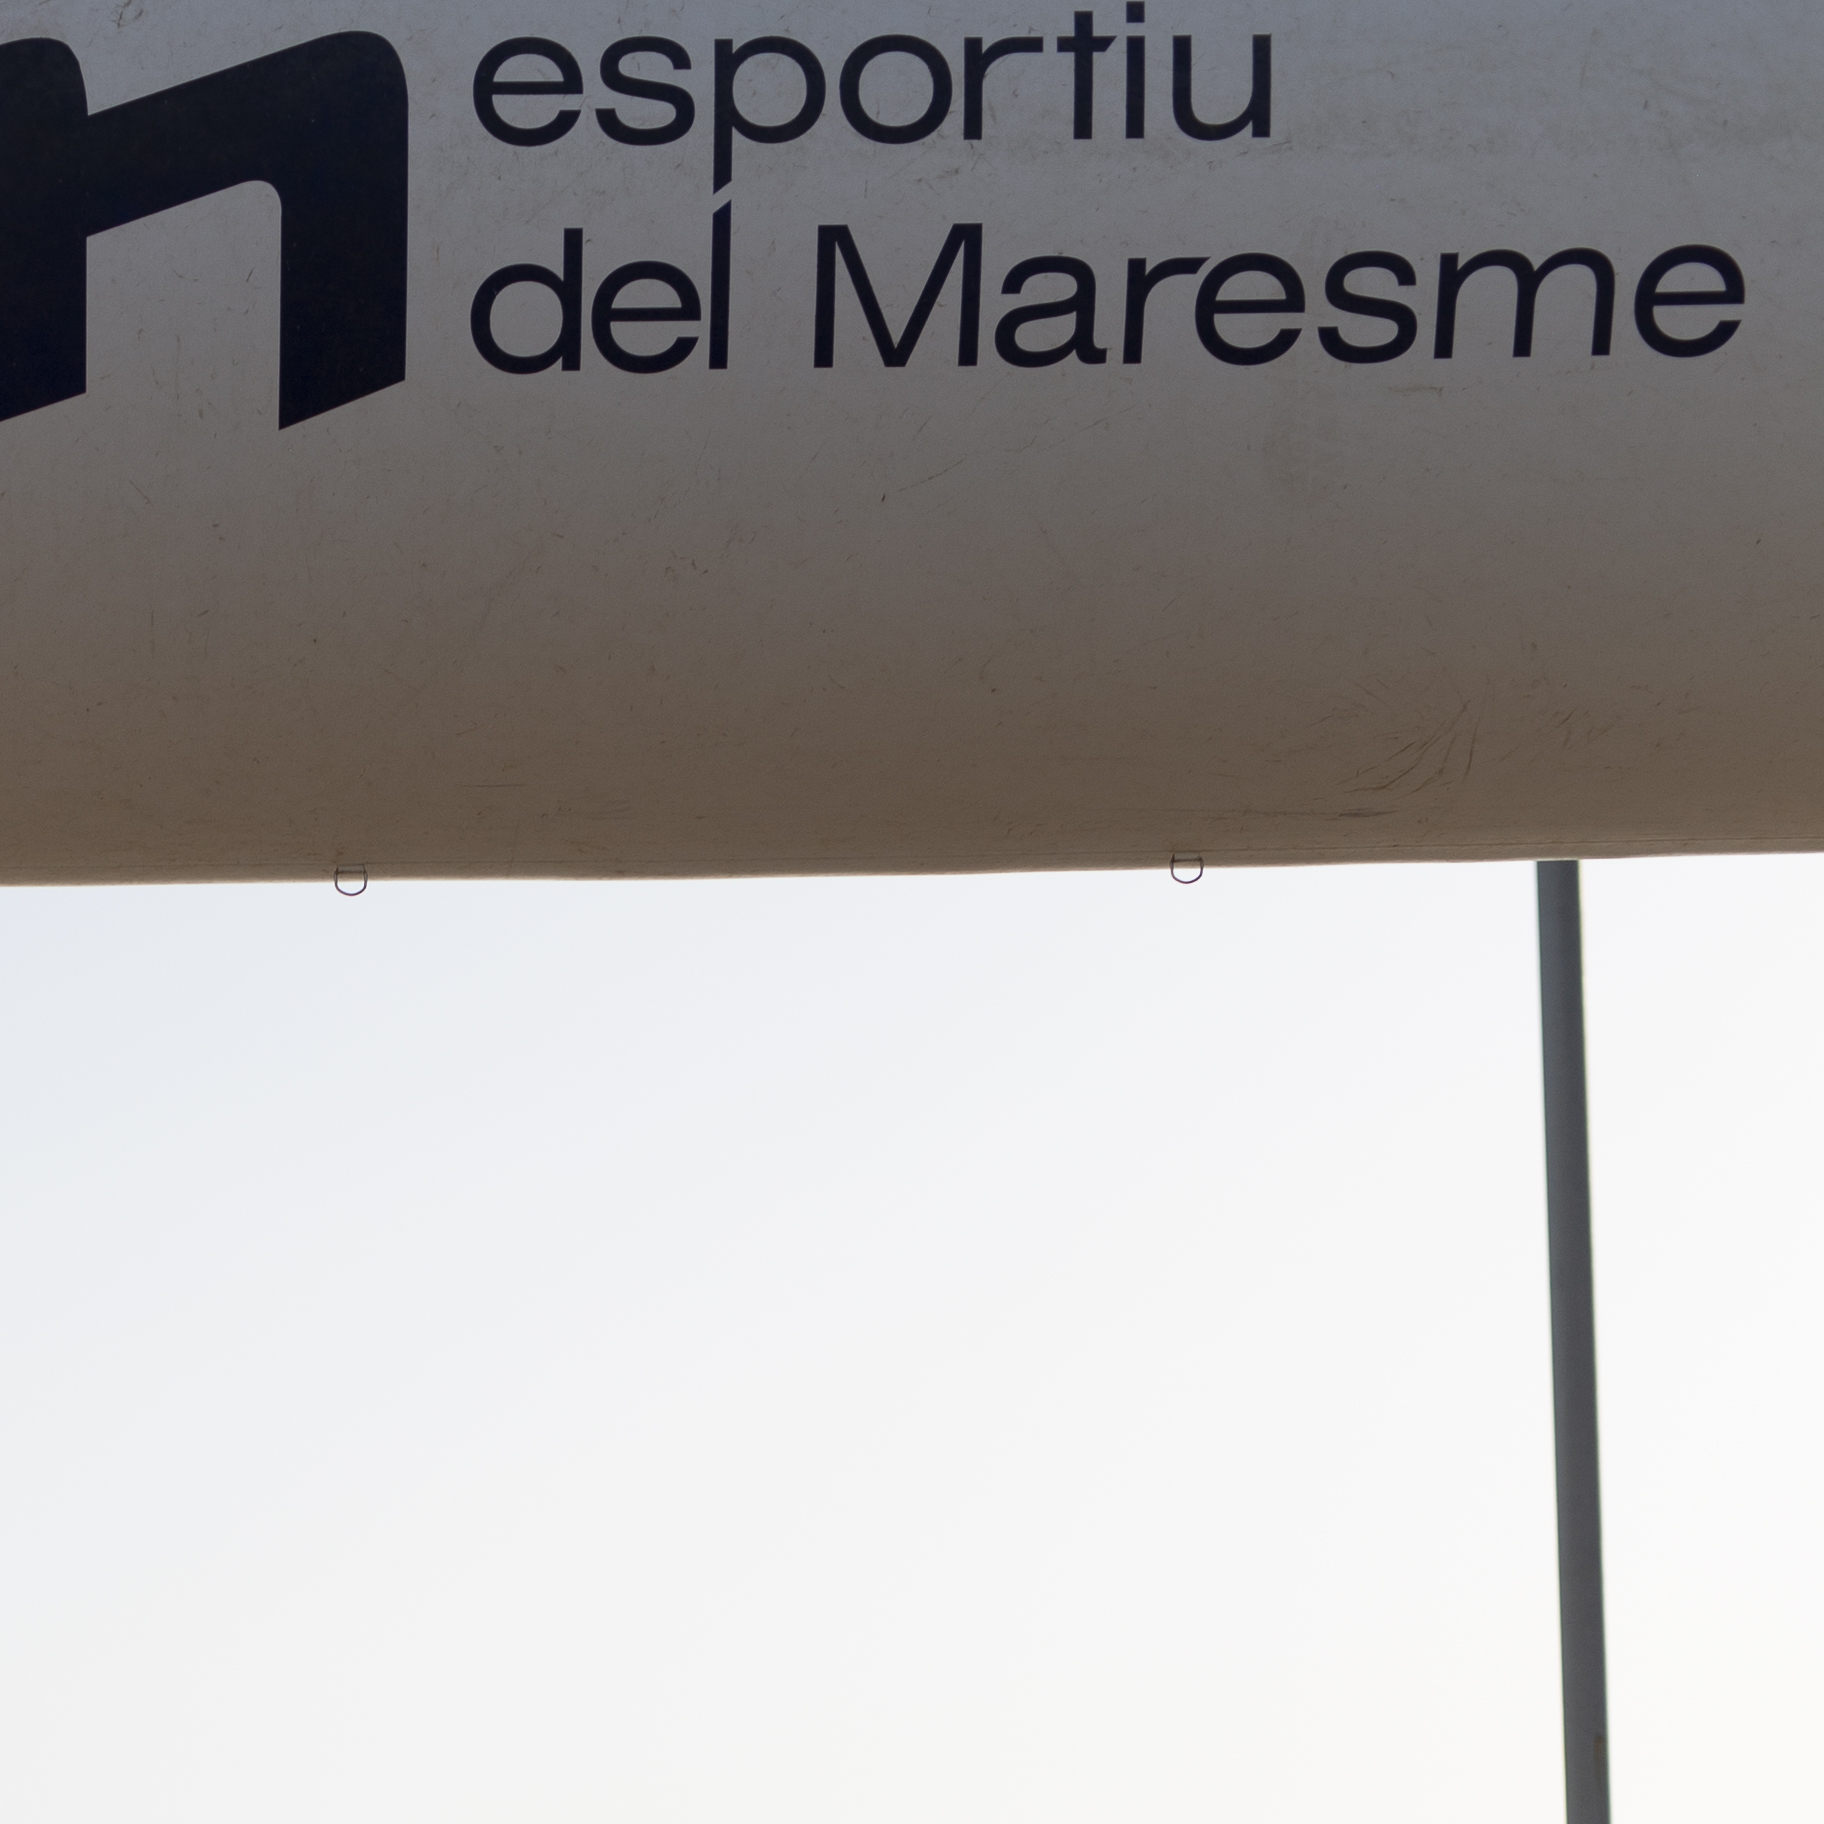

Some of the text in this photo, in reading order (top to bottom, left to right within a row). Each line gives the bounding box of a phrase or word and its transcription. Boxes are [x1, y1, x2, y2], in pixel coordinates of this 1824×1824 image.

[472, 0, 1273, 195] esportiu
[470, 199, 1746, 375] del Maresme
